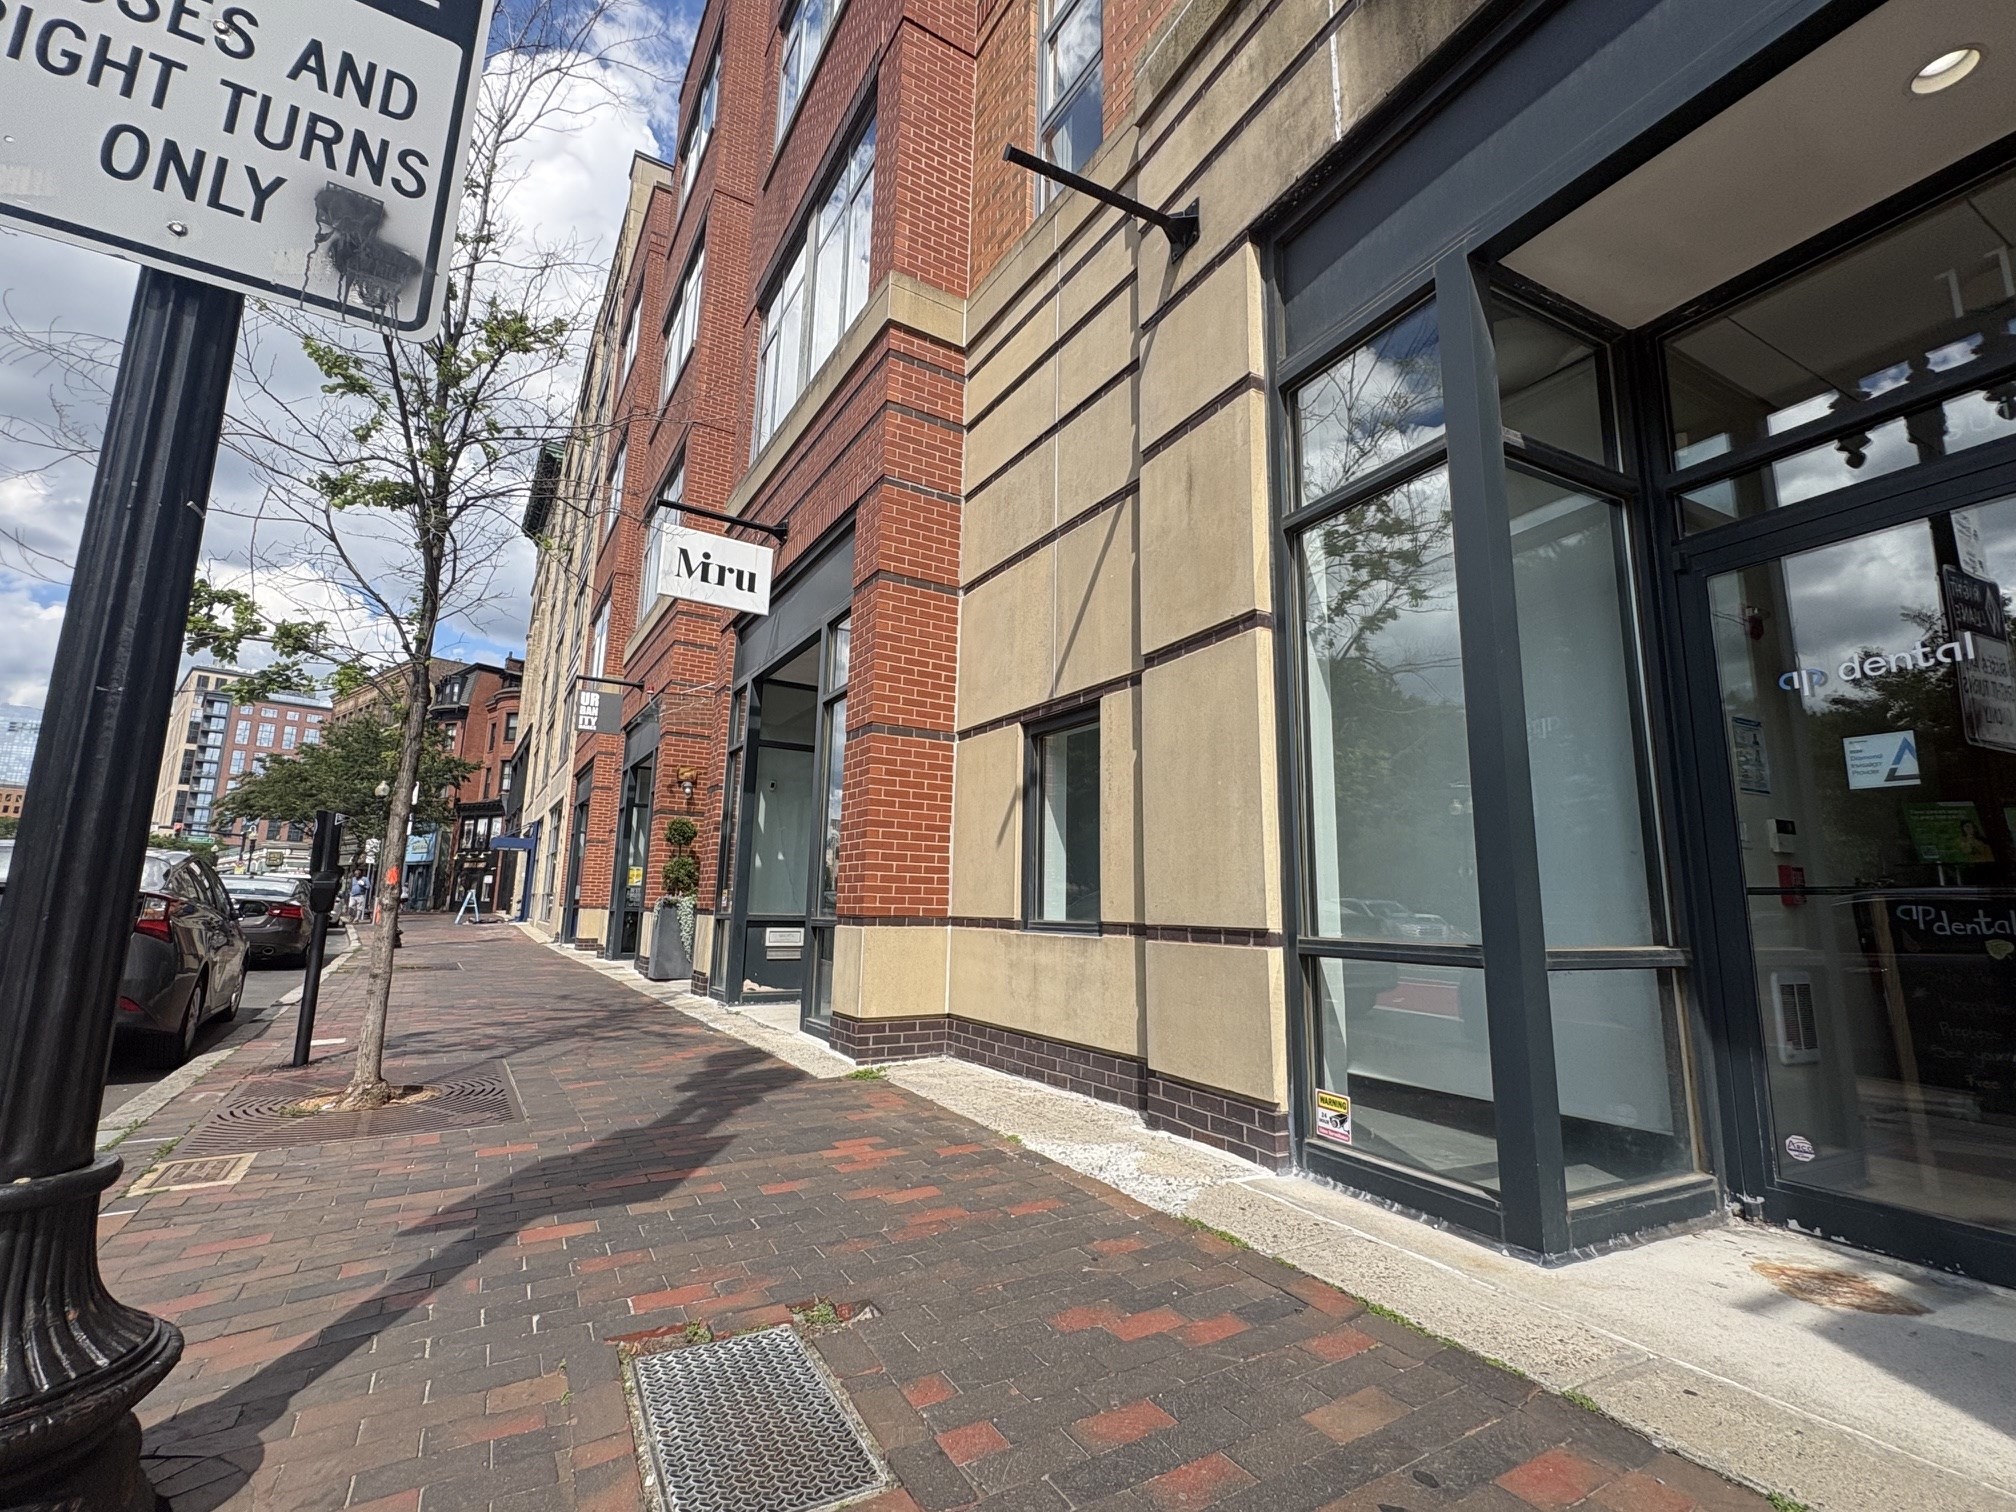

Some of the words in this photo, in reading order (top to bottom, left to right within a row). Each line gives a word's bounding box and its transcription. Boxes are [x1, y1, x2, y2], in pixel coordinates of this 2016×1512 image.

[76, 0, 259, 60] ES
[286, 38, 418, 121] AND
[219, 79, 430, 199] TURNS
[100, 124, 288, 224] ONLY
[675, 546, 758, 594] Miru
[1838, 631, 1975, 682] dental
[579, 706, 598, 717] BAN
[580, 691, 600, 707] UR
[579, 716, 597, 726] ITY
[1933, 909, 2016, 936] dental
[1320, 1096, 1346, 1110] WARNING
